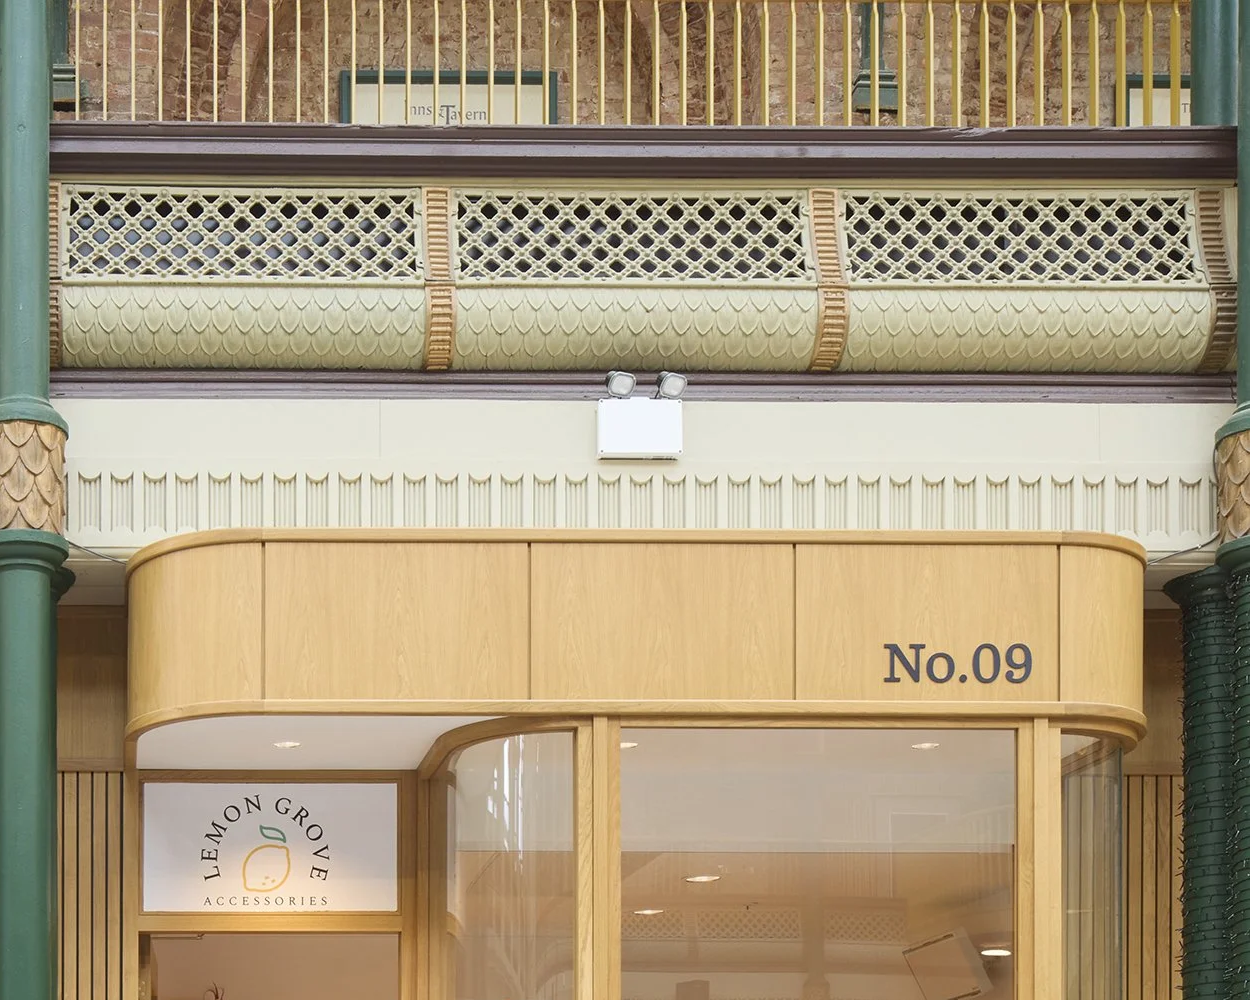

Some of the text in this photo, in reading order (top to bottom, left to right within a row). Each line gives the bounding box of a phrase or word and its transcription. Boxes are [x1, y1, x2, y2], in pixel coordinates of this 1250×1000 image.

[884, 643, 1032, 683] No.09
[200, 795, 330, 881] LEMON GROVE
[204, 896, 328, 906] ACCESSORIES
